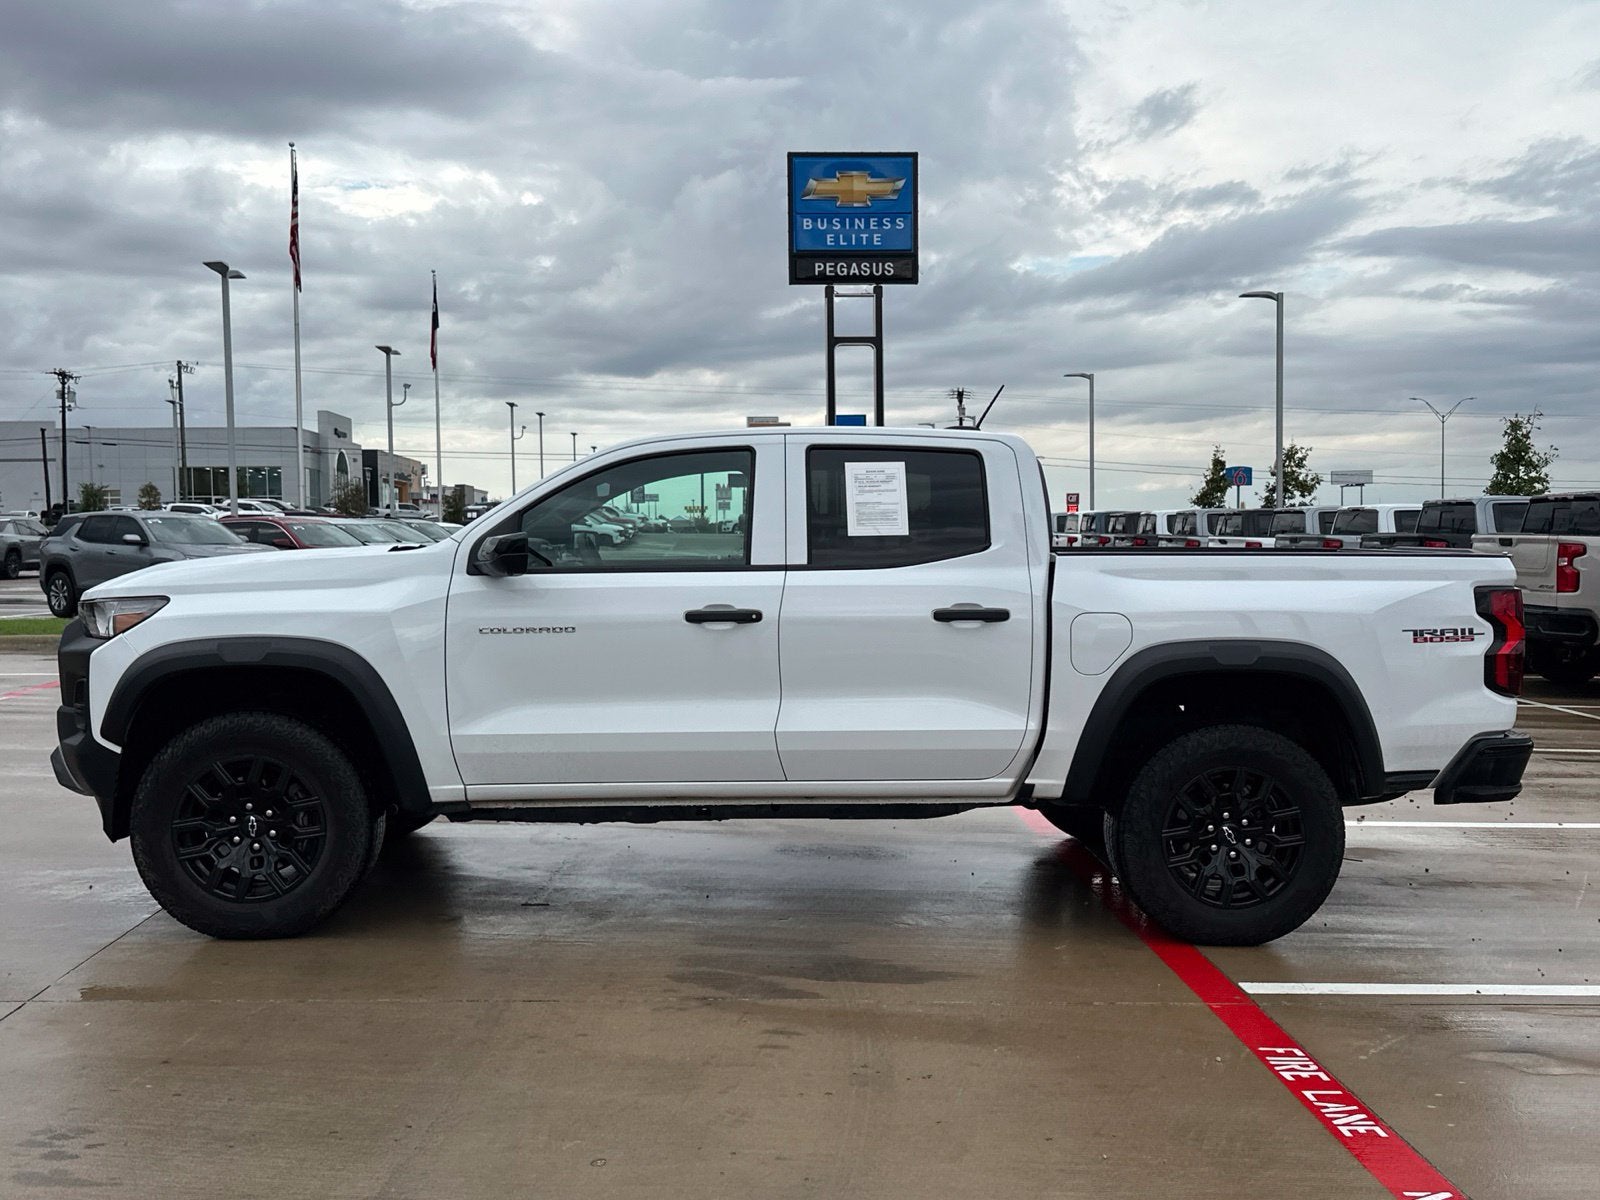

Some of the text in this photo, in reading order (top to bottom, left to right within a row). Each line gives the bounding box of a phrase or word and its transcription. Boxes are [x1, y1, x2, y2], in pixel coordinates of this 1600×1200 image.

[803, 217, 905, 230] BUSINESS
[826, 234, 882, 246] ELITE
[814, 262, 895, 276] PEGASUS
[1233, 468, 1247, 486] 6
[479, 626, 576, 634] COLORADO
[1402, 627, 1485, 637] TRAIL
[1412, 636, 1475, 644] BOSS
[1258, 1046, 1389, 1138] FIRE LANE
